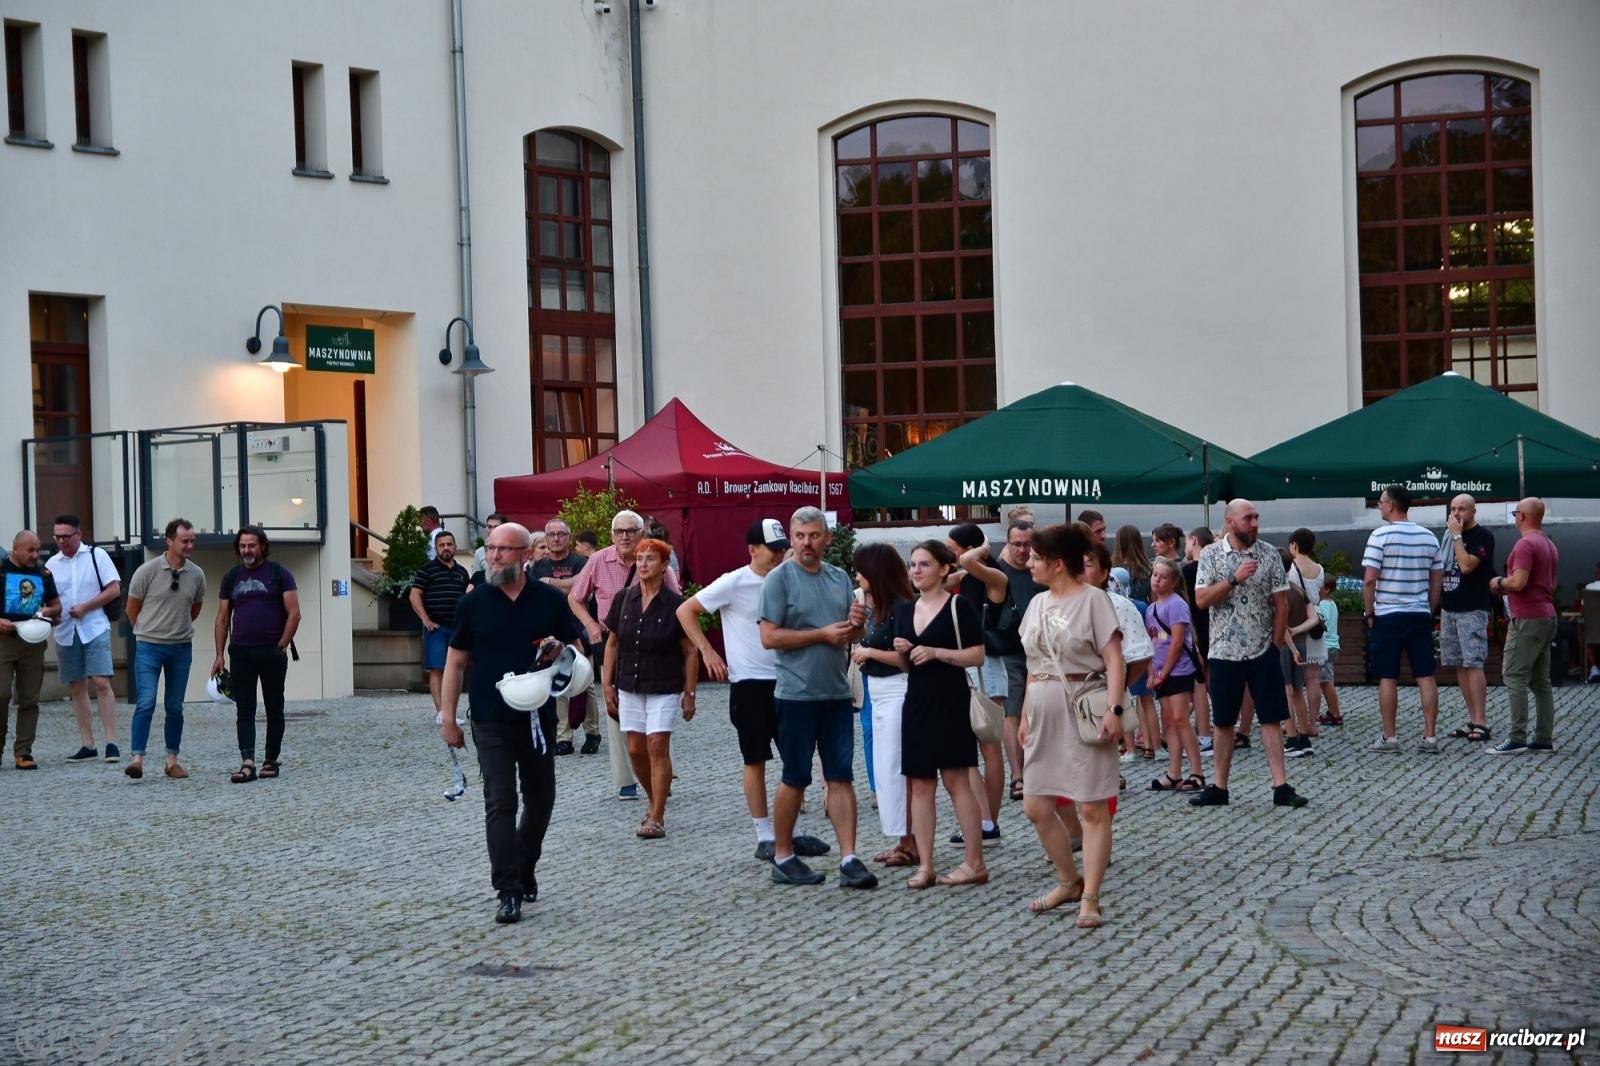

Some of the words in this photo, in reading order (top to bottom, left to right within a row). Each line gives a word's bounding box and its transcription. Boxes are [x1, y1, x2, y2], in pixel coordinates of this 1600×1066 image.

[309, 347, 371, 360] MASZYNOWNIA
[697, 481, 711, 494] A.D.
[724, 481, 751, 494] Browar
[753, 480, 788, 495] Zamkowy
[789, 480, 819, 494] Racibórz
[828, 483, 843, 496] 1567
[962, 479, 1101, 498] MASZYNOWNIA
[1406, 480, 1448, 493] Zamkowy
[1450, 480, 1492, 492] Racibórz
